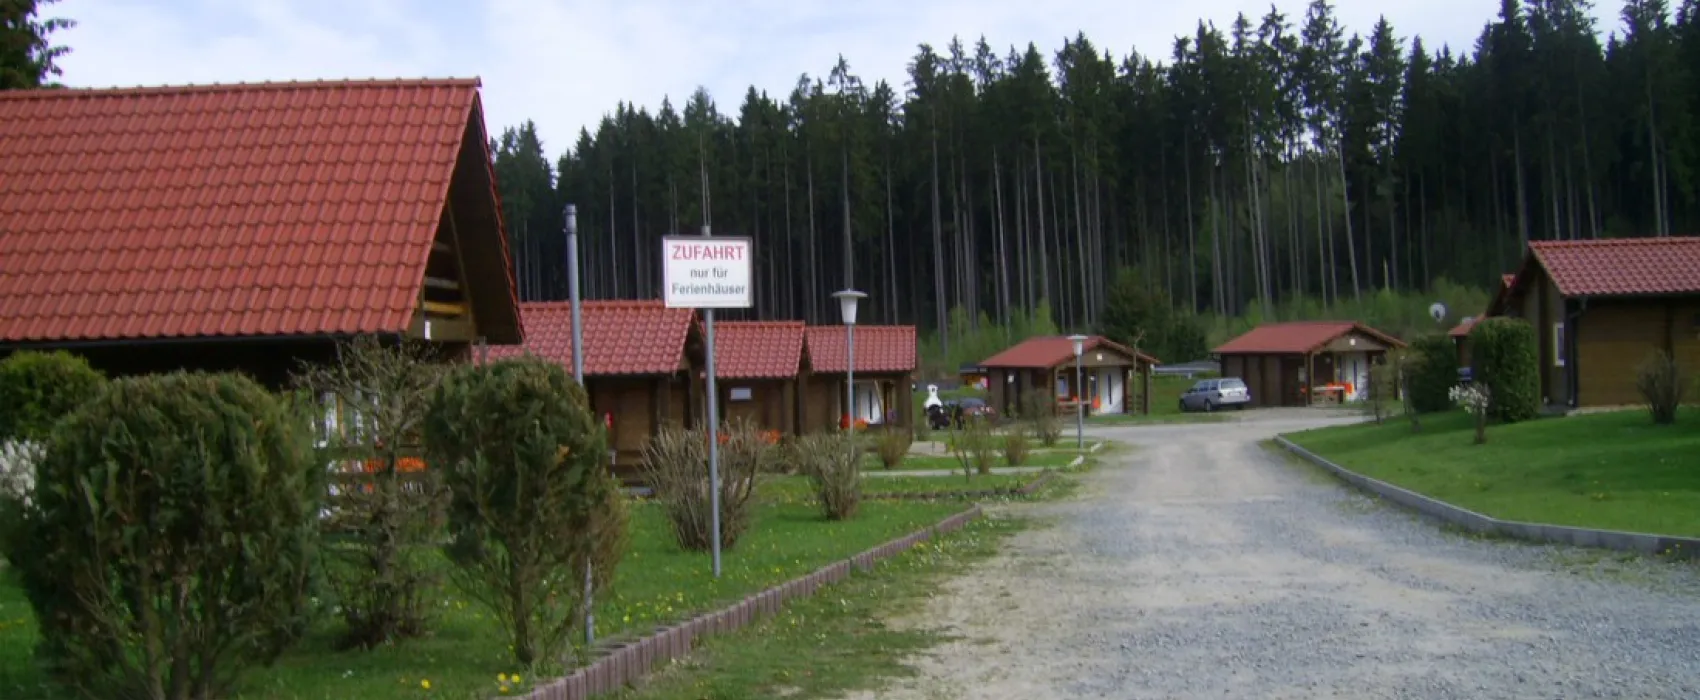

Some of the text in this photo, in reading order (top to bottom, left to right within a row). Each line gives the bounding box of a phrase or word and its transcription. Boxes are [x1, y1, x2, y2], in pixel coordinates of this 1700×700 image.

[672, 244, 744, 260] ZUFAHRT
[690, 266, 728, 278] nur für
[671, 282, 745, 295] Ferienhäuser
